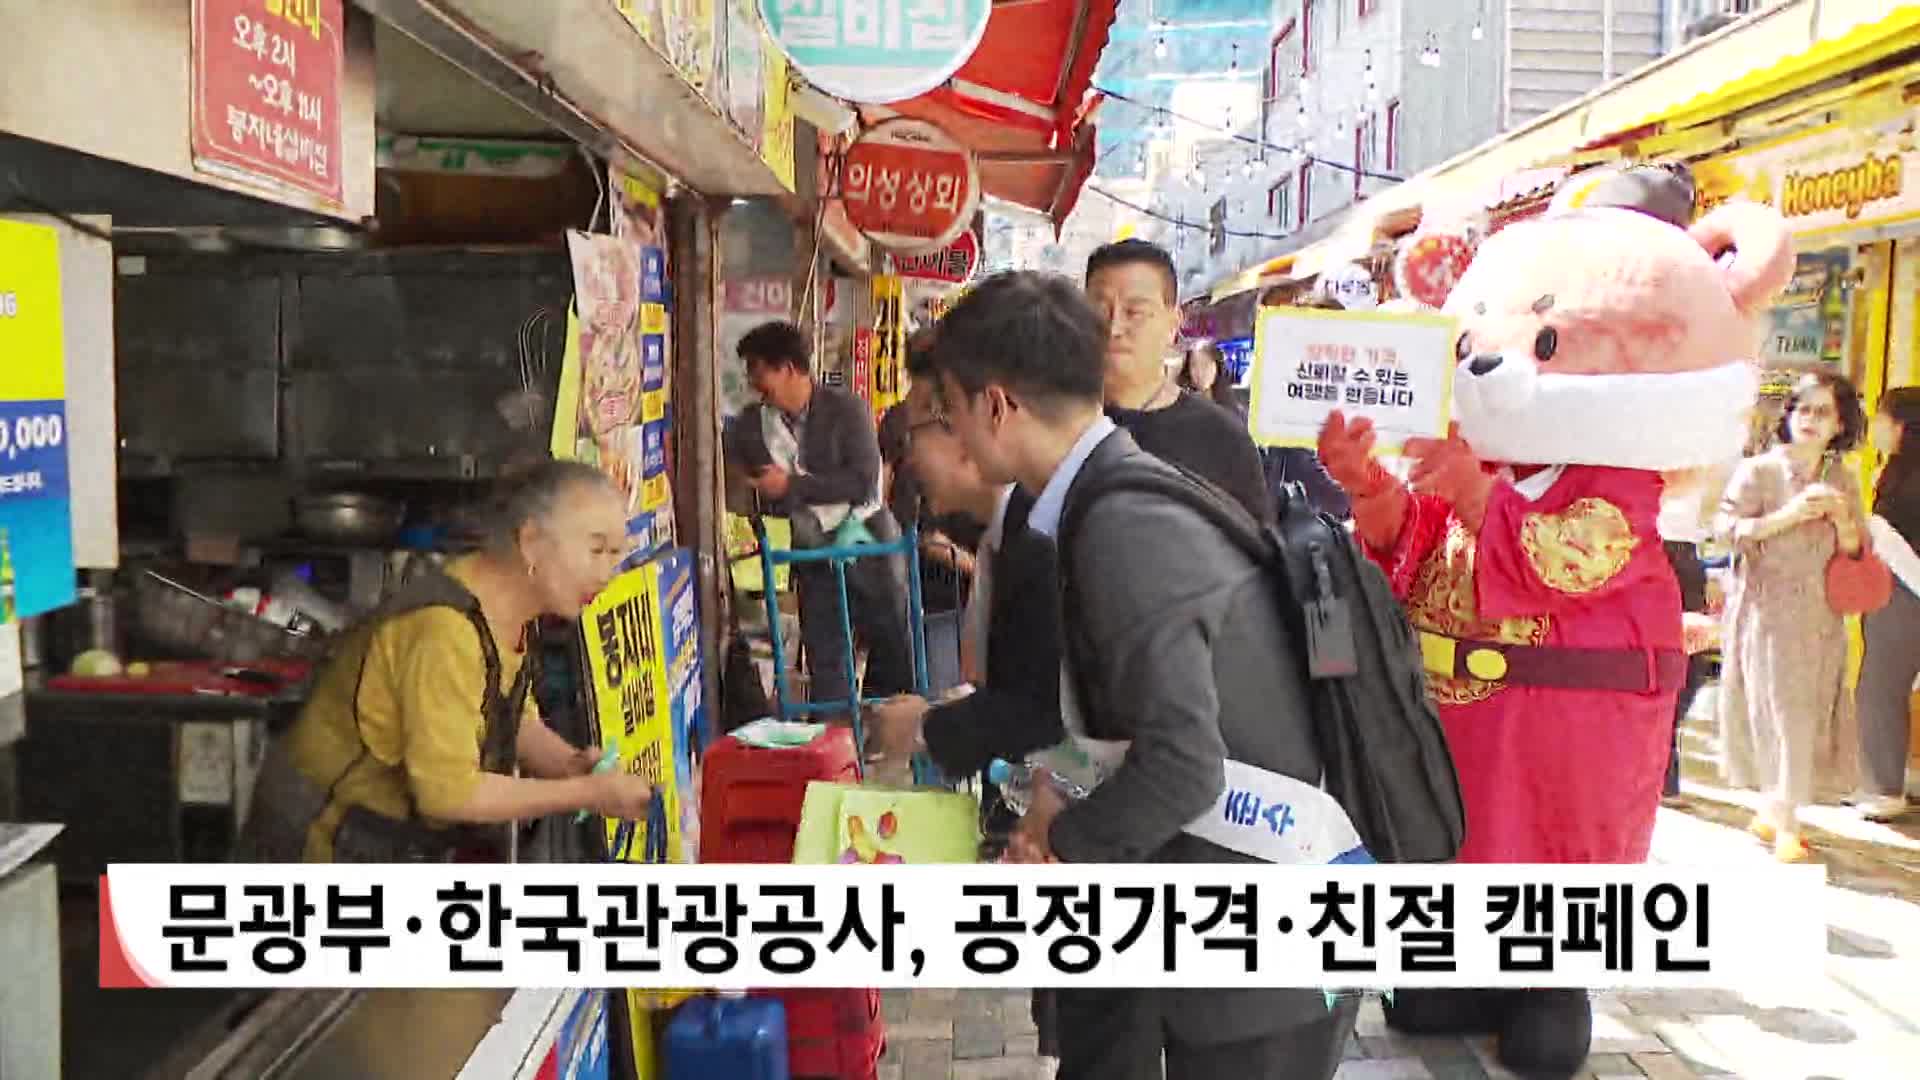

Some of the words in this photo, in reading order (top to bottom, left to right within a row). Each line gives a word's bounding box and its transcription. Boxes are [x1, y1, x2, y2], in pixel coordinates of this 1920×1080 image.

[232, 15, 267, 60] 오후
[844, 162, 961, 215] 의성상회
[1352, 367, 1371, 382] 수
[1375, 368, 1409, 387] 있는
